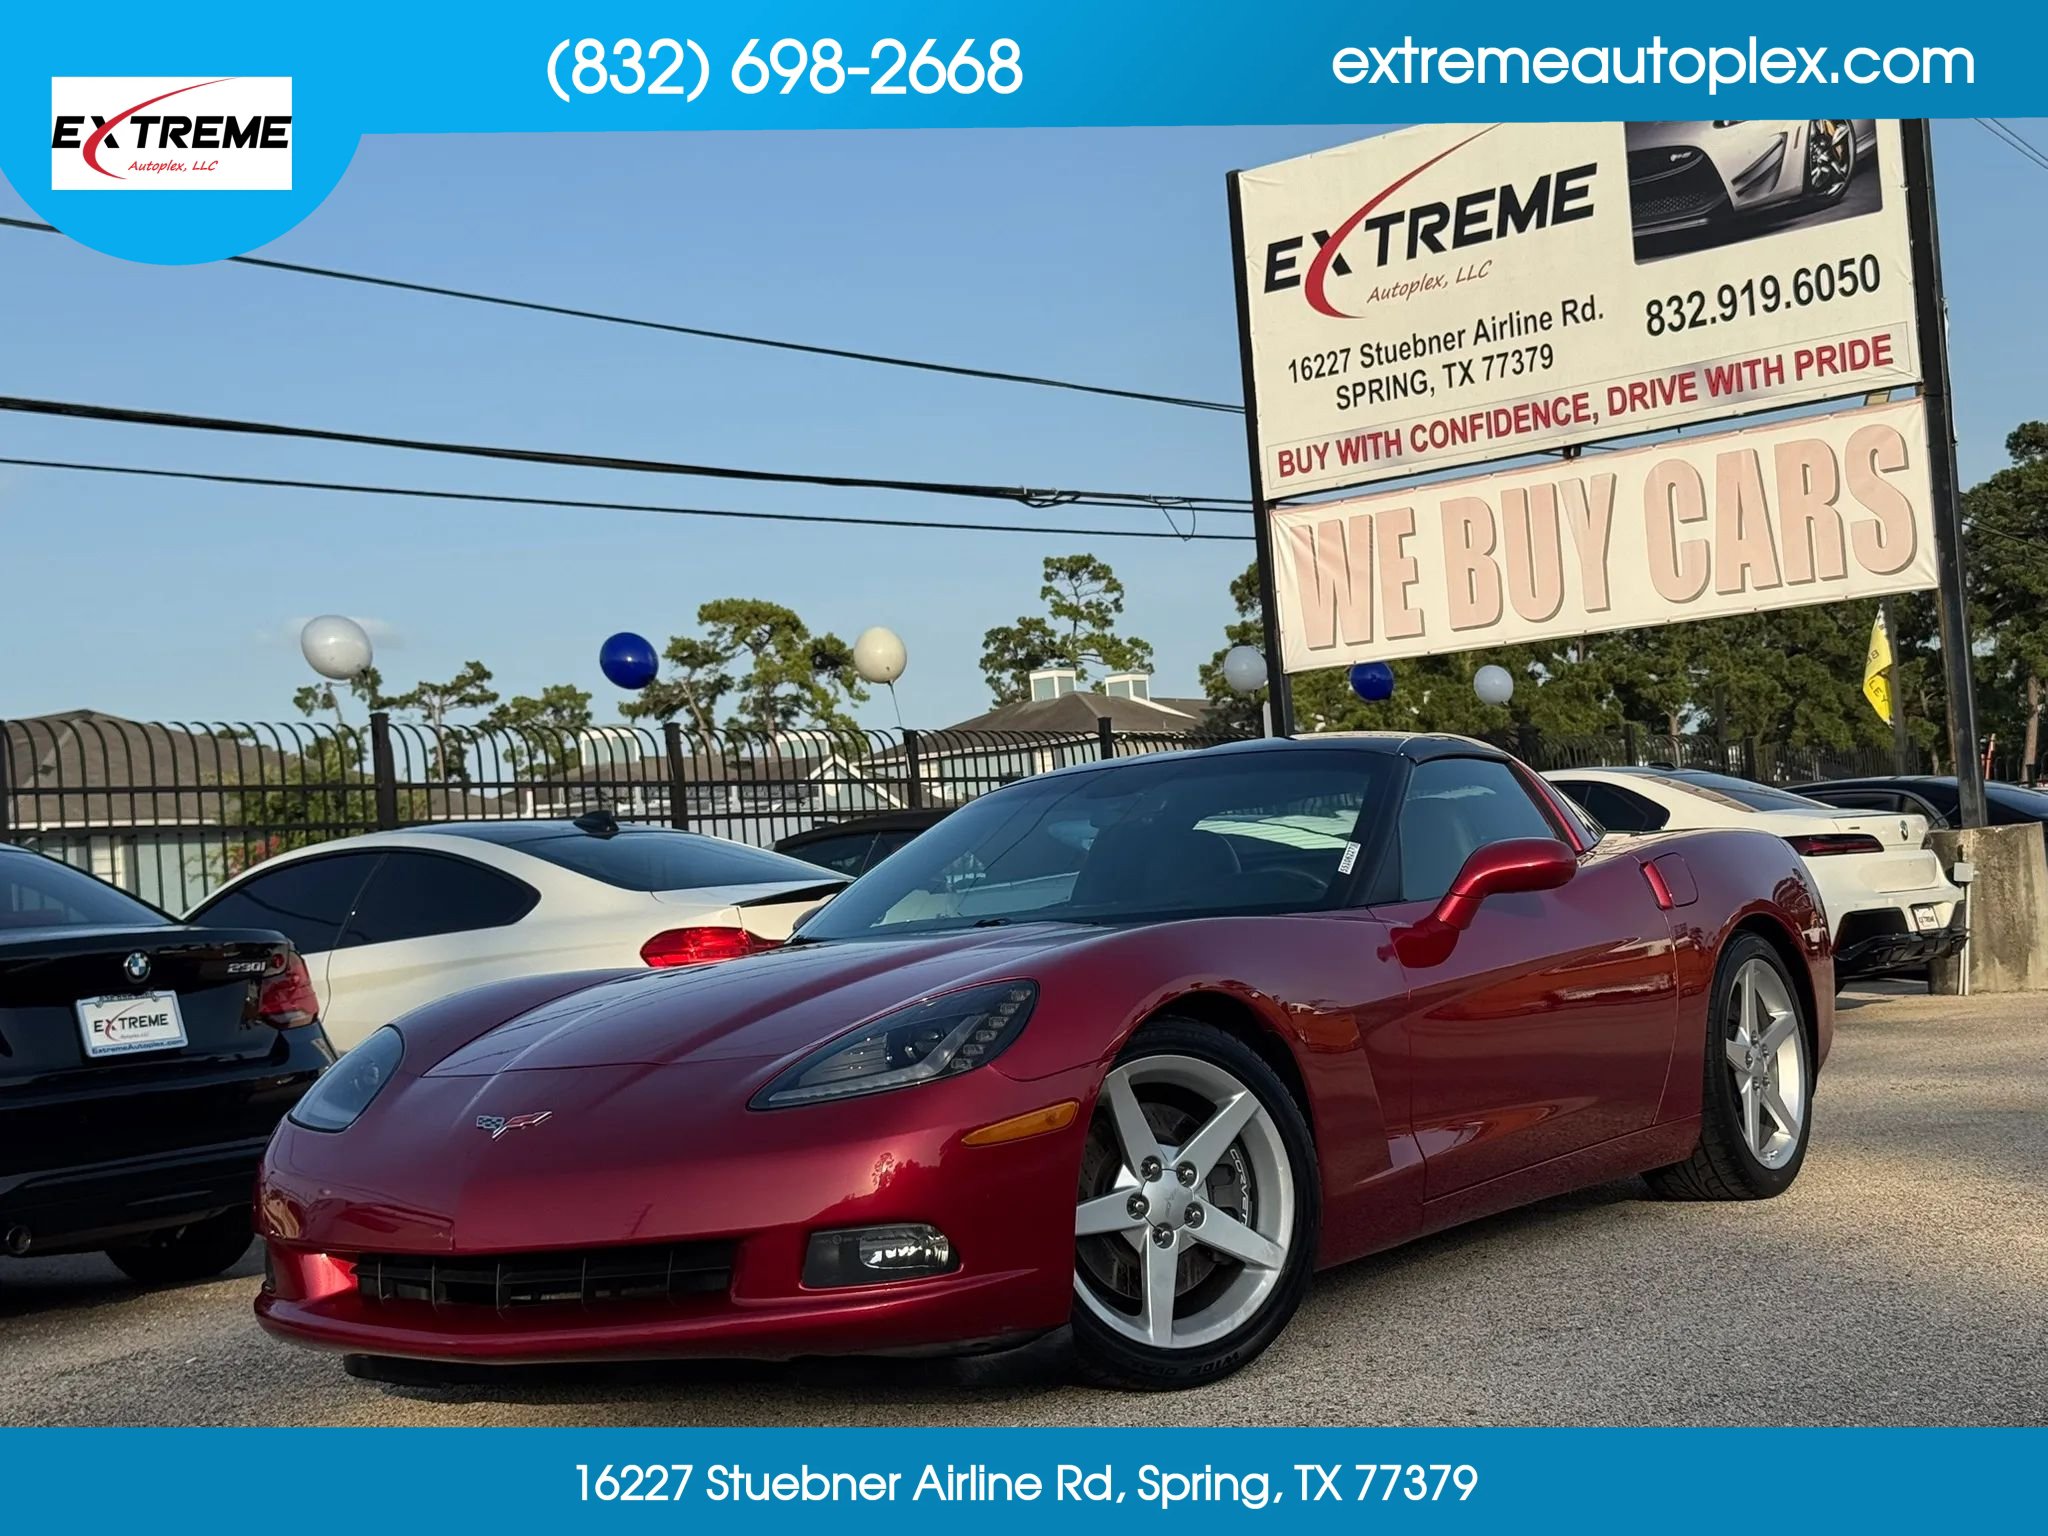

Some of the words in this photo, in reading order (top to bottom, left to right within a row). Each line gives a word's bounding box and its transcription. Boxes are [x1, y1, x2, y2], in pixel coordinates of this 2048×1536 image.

[1264, 162, 1598, 294] EXTREME
[1367, 272, 1449, 304] Autoplex,
[1455, 259, 1493, 284] LLC
[1646, 253, 1881, 337] 832.919.6050
[1288, 347, 1352, 384] 16227
[1360, 328, 1467, 369] Stuebner
[1473, 310, 1553, 347] Airline
[1561, 294, 1604, 327] Rd.
[1336, 368, 1436, 411] SPRING,
[1442, 358, 1476, 389] TX
[1482, 343, 1554, 381] 77379
[1277, 442, 1330, 478] BUY
[1336, 428, 1403, 466] WITH
[1409, 392, 1600, 454] CONFIDENCE,
[1607, 371, 1698, 417] DRIVE
[1704, 354, 1785, 397] WITH
[1794, 333, 1894, 382] PRIDE
[1290, 506, 1424, 650] WE
[1440, 472, 1617, 632] BUY
[1643, 423, 1918, 604] CARS
[94, 1013, 169, 1033] EXTREME
